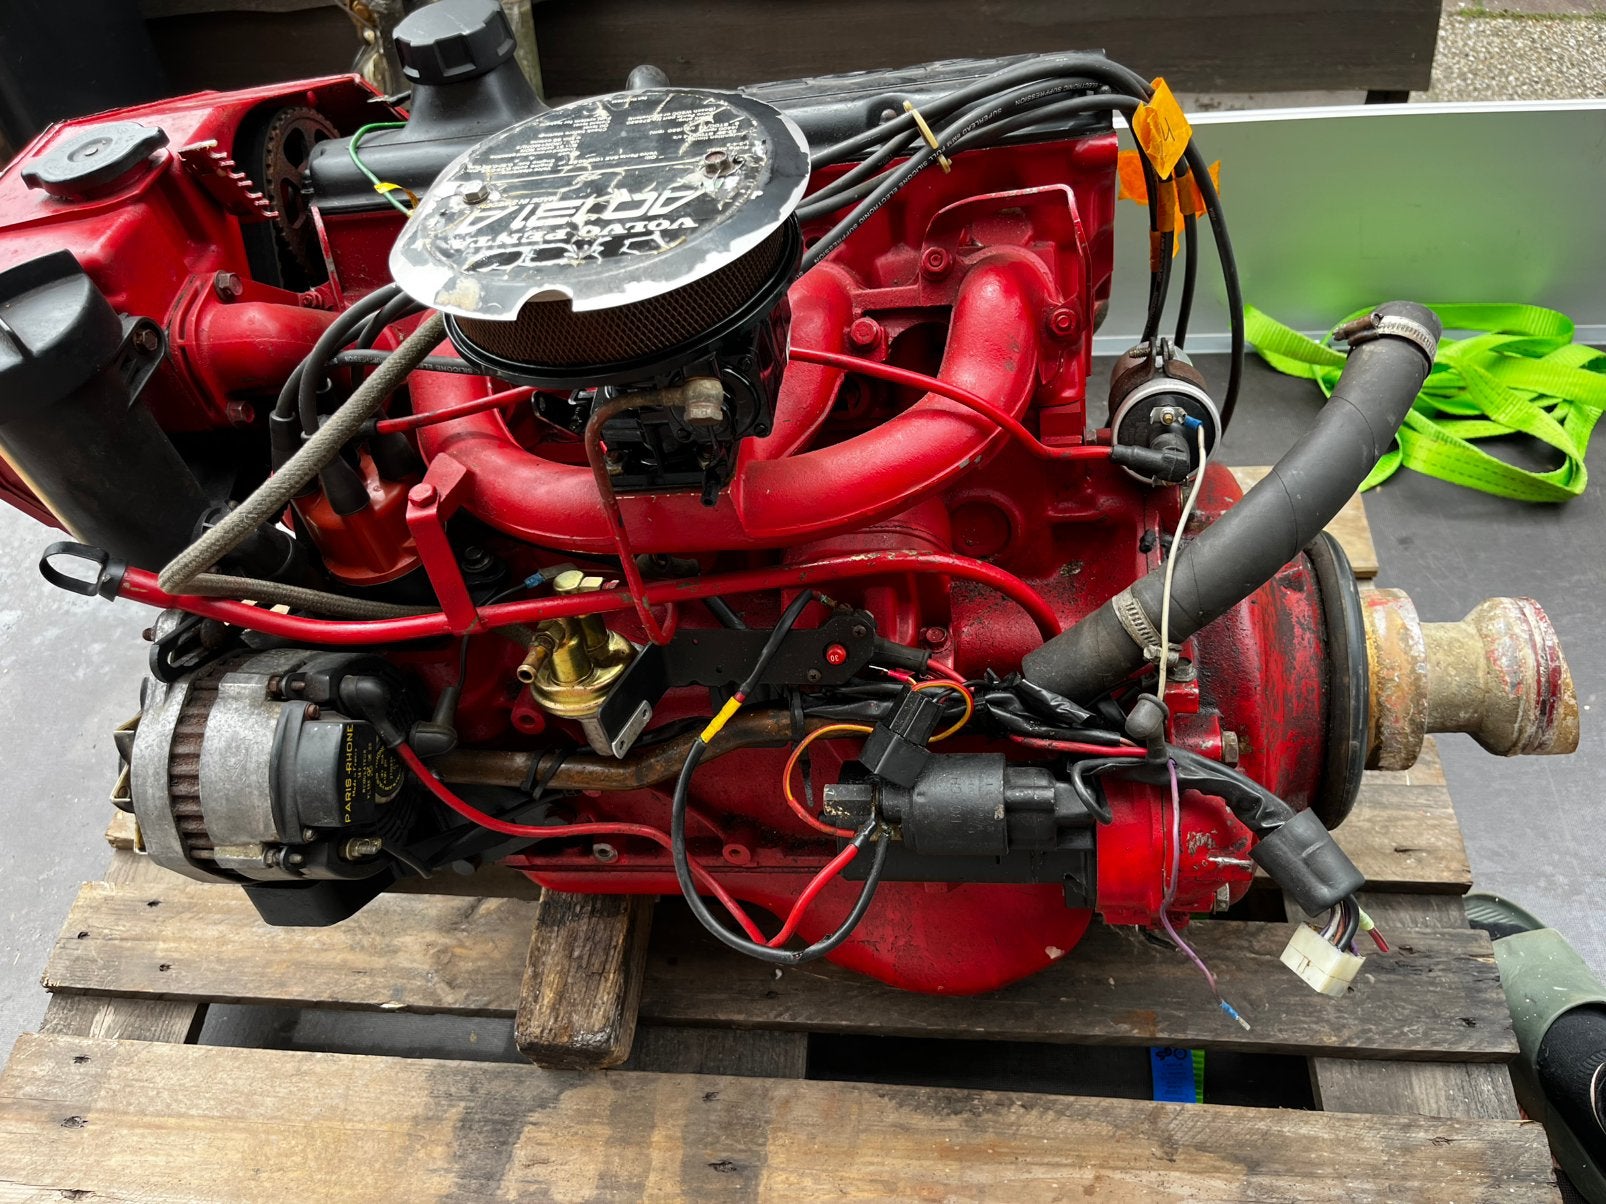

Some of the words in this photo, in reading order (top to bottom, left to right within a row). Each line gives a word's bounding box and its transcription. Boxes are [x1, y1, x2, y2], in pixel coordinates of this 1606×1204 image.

[1015, 86, 1062, 106] SUPPRESSION
[962, 107, 1002, 135] SUPERLEAD
[928, 146, 946, 161] FULL
[899, 160, 928, 187] SILICONE
[859, 187, 897, 223] ELECTRONIC
[448, 229, 570, 249] PENTA
[578, 217, 698, 240] VOLVO
[814, 224, 857, 263] SUPPRESSION
